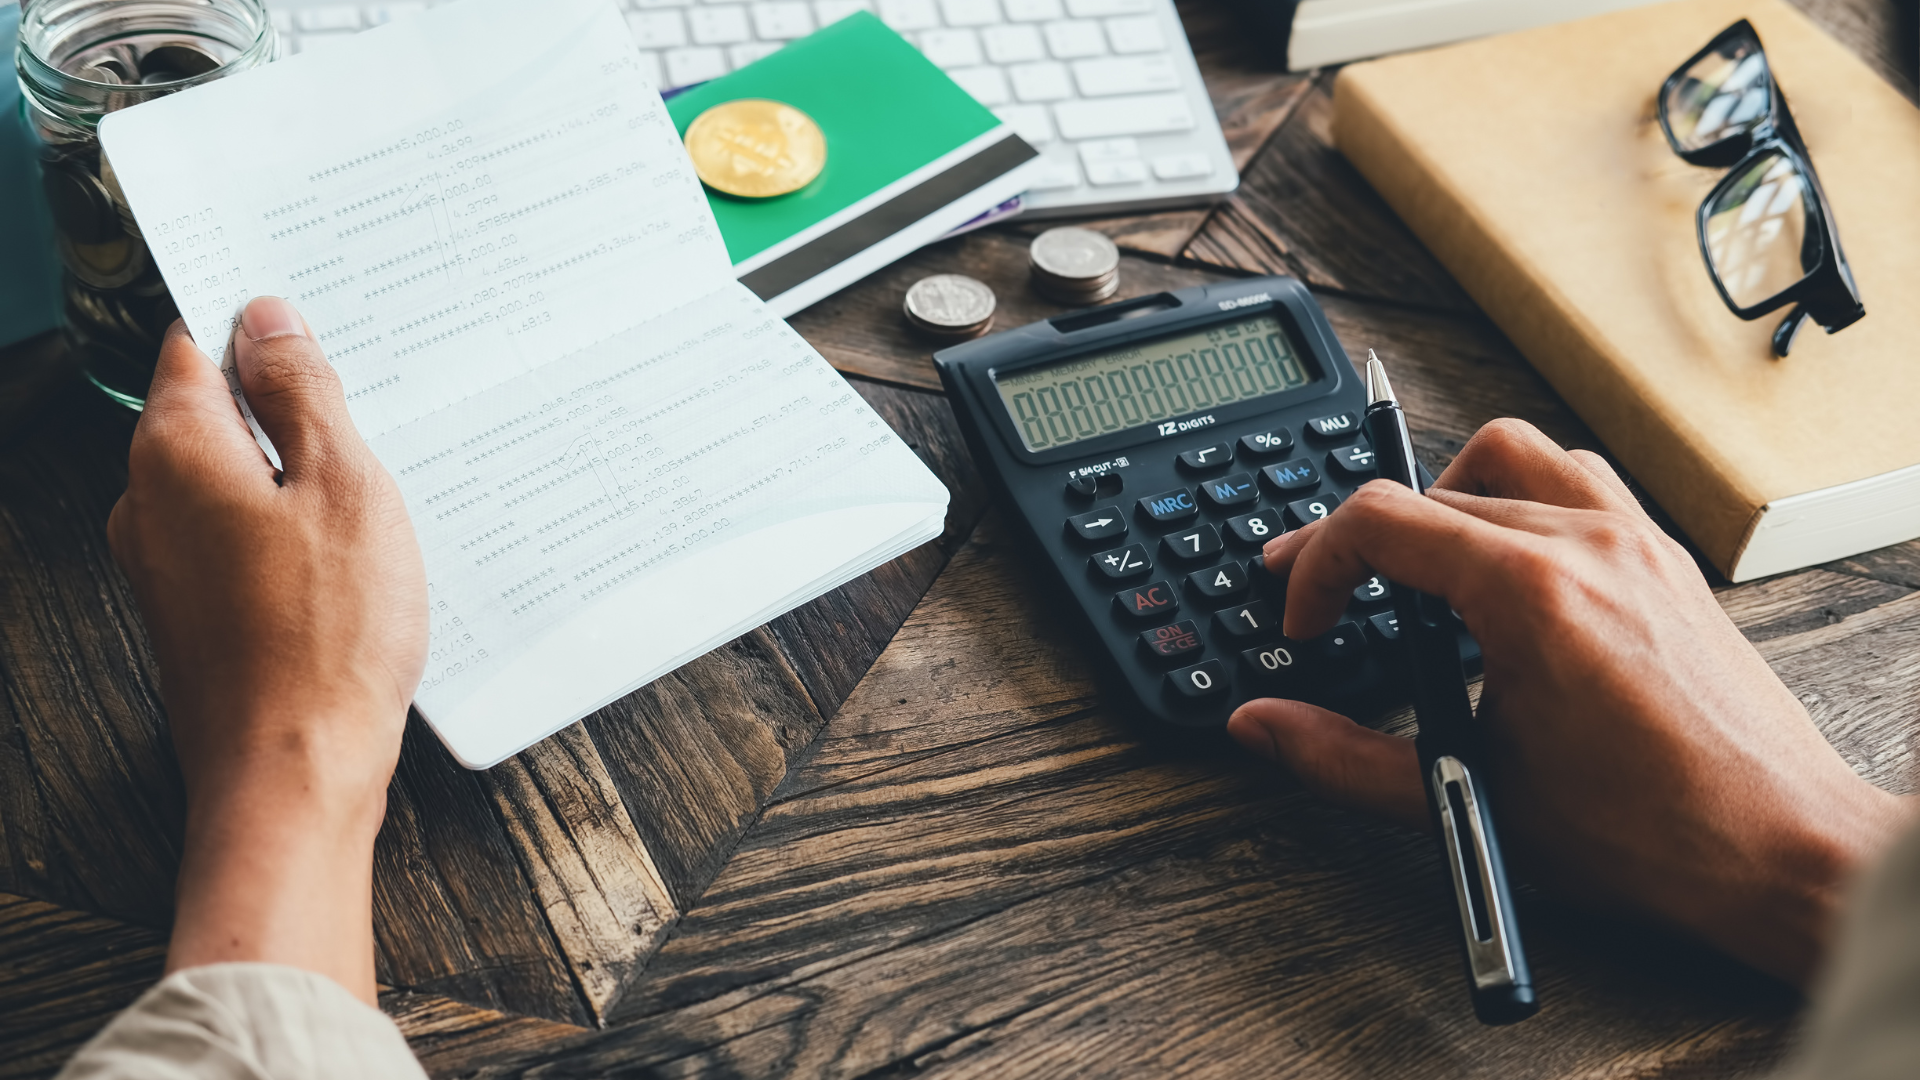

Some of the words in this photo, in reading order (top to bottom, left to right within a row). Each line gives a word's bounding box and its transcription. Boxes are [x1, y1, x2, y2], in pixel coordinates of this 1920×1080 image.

[165, 226, 223, 255] 12/07/17
[427, 136, 473, 160] 4.3699
[155, 208, 213, 236] 12/07/17
[173, 247, 230, 276] 12/07/17
[191, 289, 248, 317] 01/08/17
[453, 194, 498, 219] 4.3799
[482, 254, 529, 277] 4.6266
[183, 267, 240, 296] 01/08/17
[506, 310, 552, 337] 4.6813
[1050, 360, 1097, 378] MEMORY
[1104, 350, 1142, 365] ERROR
[582, 406, 628, 431] 4.6458
[1158, 421, 1178, 436] 12
[1178, 414, 1216, 431] DIGITS
[1320, 414, 1350, 432] MU
[1255, 432, 1282, 448] %
[618, 446, 664, 473] 4.7120
[1069, 471, 1076, 479] F
[1274, 466, 1311, 484] M+
[658, 488, 704, 517] 4.3867
[1150, 493, 1193, 516] MRC
[1308, 502, 1328, 519] 9
[1247, 517, 1269, 536] 8
[1183, 533, 1200, 552] 7
[1214, 570, 1232, 588] 4
[1367, 576, 1385, 597] 3
[1135, 588, 1168, 611] AC
[1239, 608, 1259, 629] 1
[1156, 624, 1183, 639] ON
[422, 648, 489, 690] 06/02/18
[1259, 647, 1293, 670] 00
[1190, 670, 1212, 689] 0
